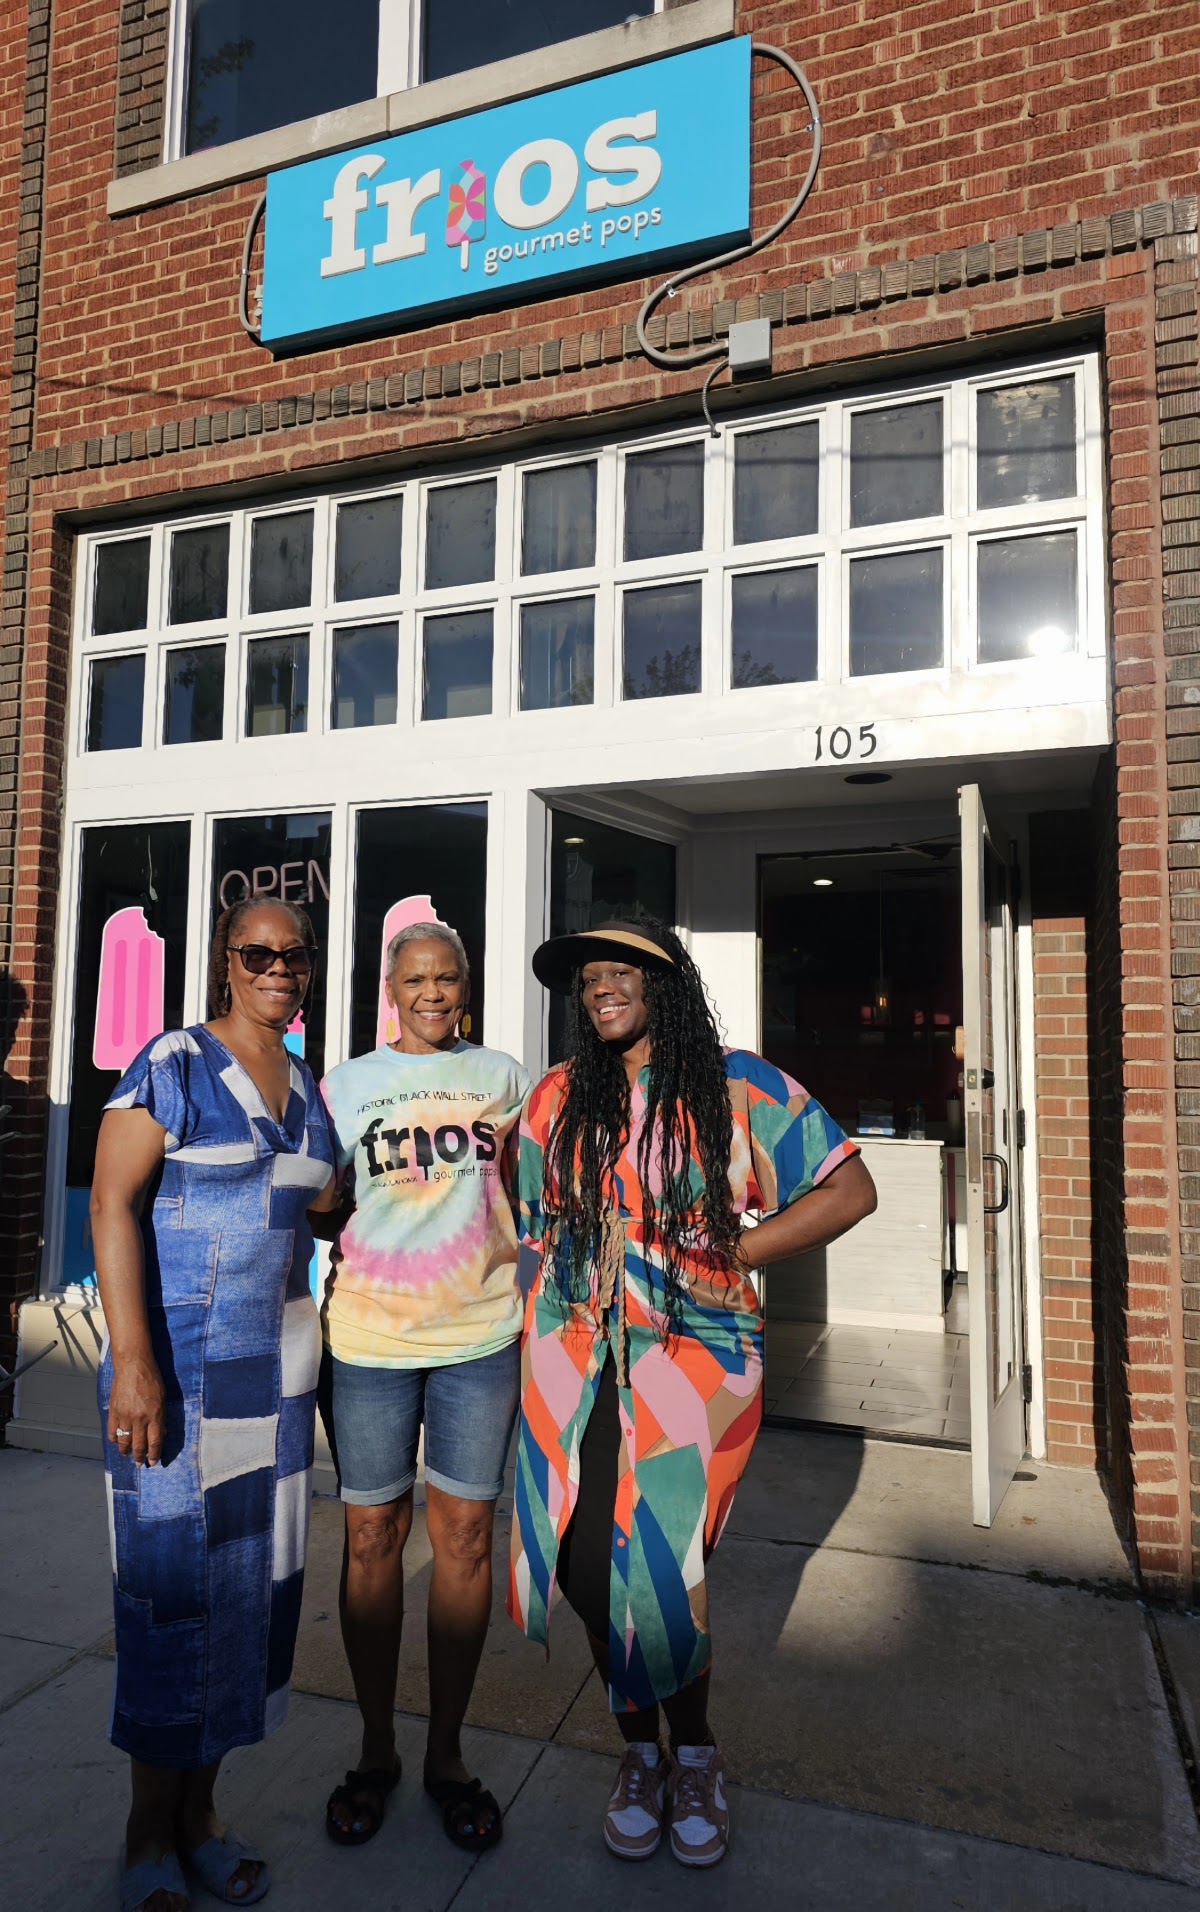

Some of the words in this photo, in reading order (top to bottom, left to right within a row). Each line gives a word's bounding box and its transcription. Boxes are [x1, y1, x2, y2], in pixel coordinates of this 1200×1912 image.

[320, 109, 663, 279] frios
[484, 221, 593, 275] gourmet
[601, 206, 662, 247] pops
[815, 722, 877, 761] 105
[220, 859, 332, 911] OPEN
[357, 1095, 397, 1116] HISTORIC
[399, 1090, 431, 1102] BLACK
[433, 1090, 460, 1101] WALL
[461, 1092, 493, 1102] STREET
[360, 1117, 498, 1181] frios
[433, 1165, 476, 1183] gourmet
